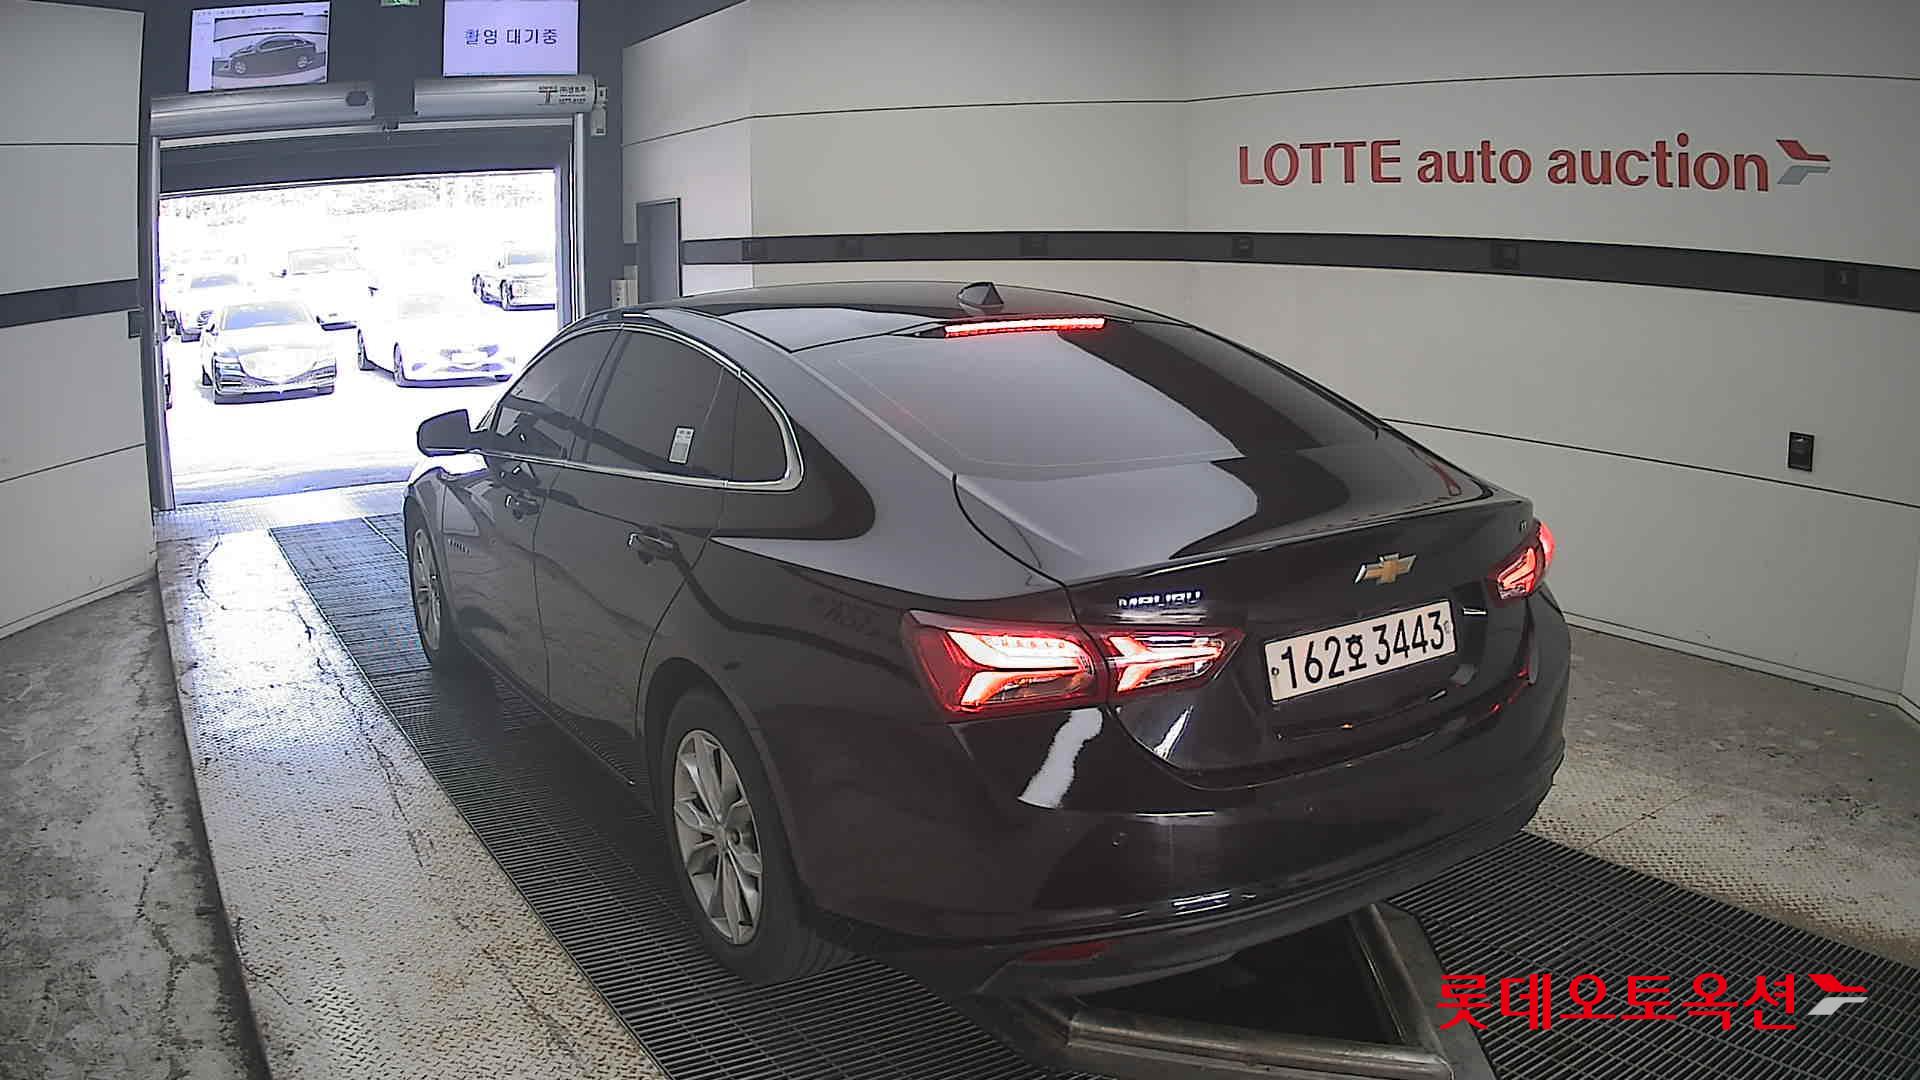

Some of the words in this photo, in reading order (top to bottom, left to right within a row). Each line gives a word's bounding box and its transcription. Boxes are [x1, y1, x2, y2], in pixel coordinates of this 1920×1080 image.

[506, 28, 557, 45] 대기중
[1239, 139, 1401, 185] LOTTE
[1416, 139, 1532, 184] auto
[1548, 133, 1768, 192] auction
[1372, 611, 1443, 665] 3443
